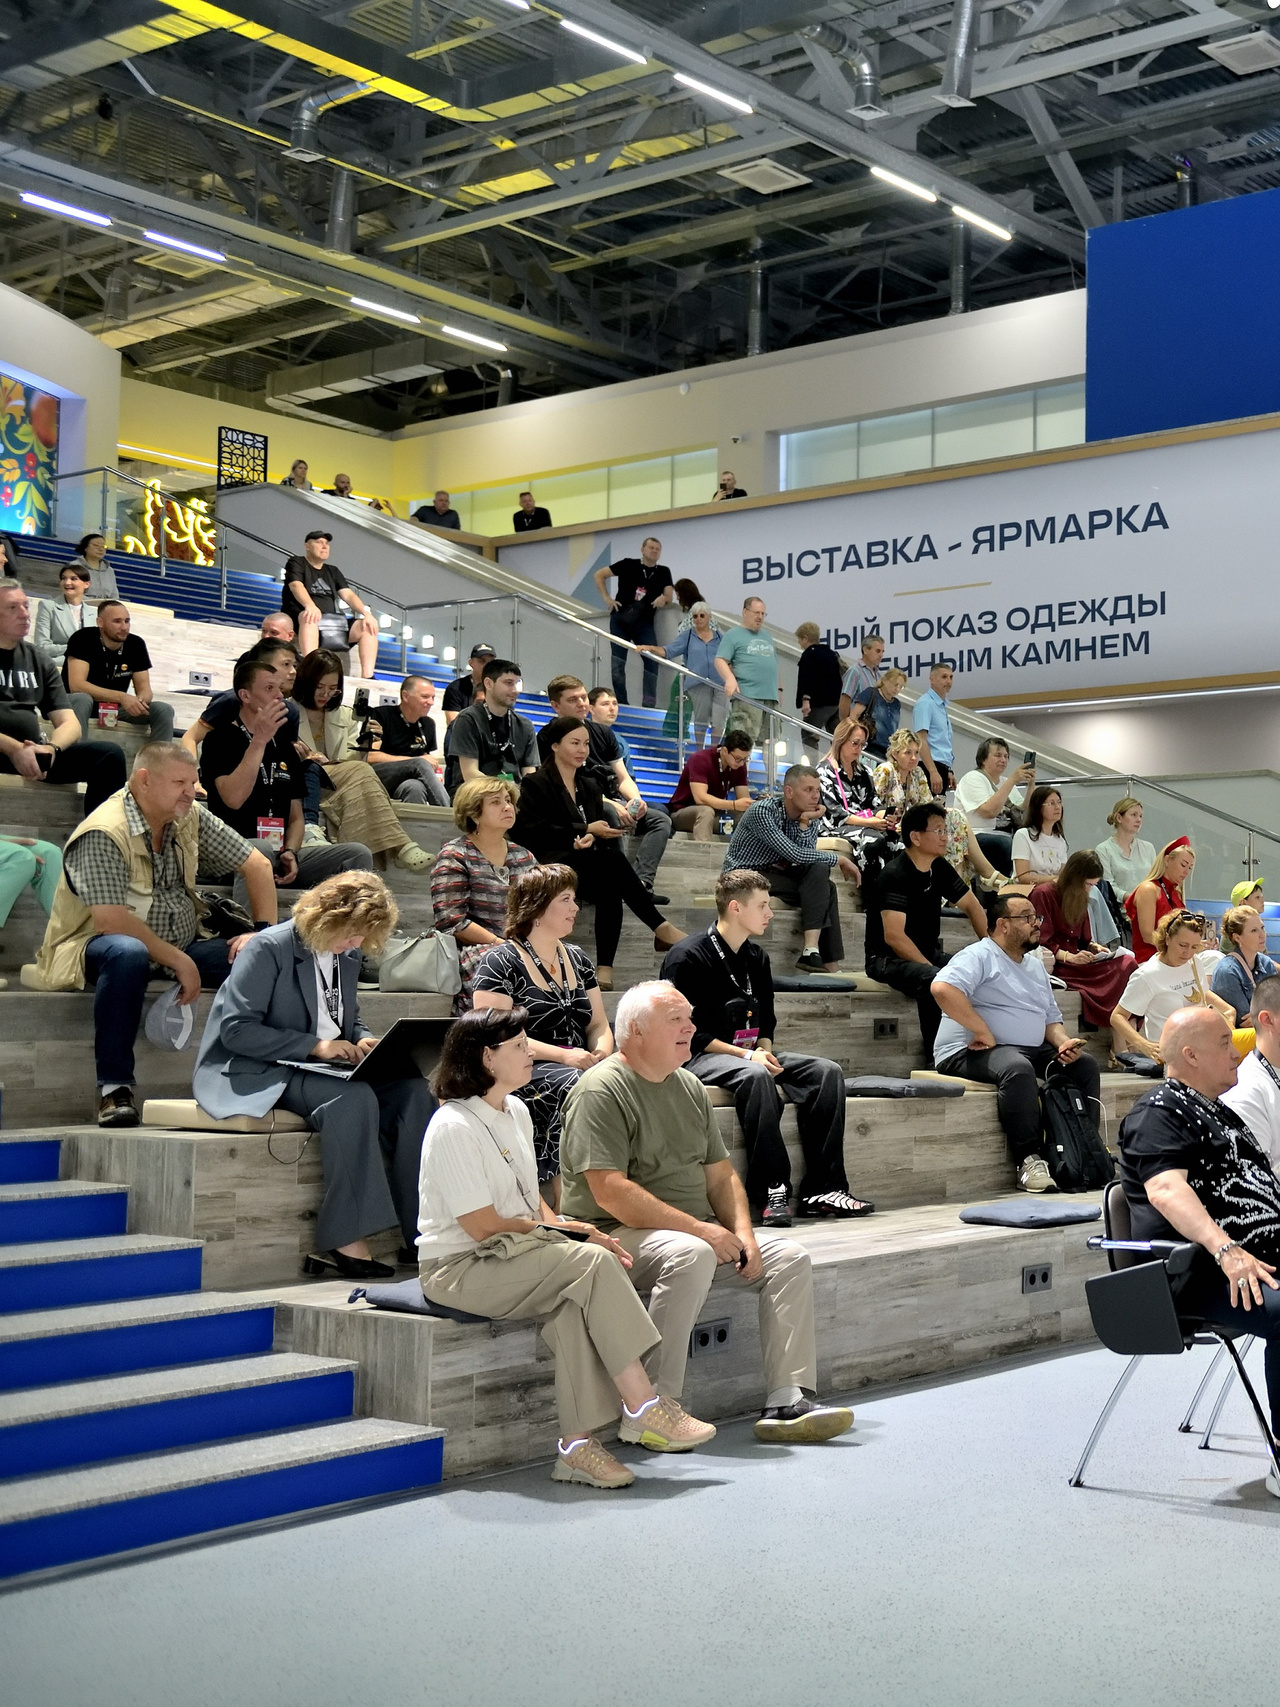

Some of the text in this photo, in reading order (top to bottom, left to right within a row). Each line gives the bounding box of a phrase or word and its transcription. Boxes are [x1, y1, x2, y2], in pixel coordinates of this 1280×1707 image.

[742, 534, 939, 584] ВЫСТАВКА
[971, 501, 1170, 555] ЯРМАРКА
[889, 610, 998, 644] ПОКАЗ
[1006, 591, 1166, 633] ОДЕЖДЫ
[1001, 630, 1150, 668] КАМНЕМ
